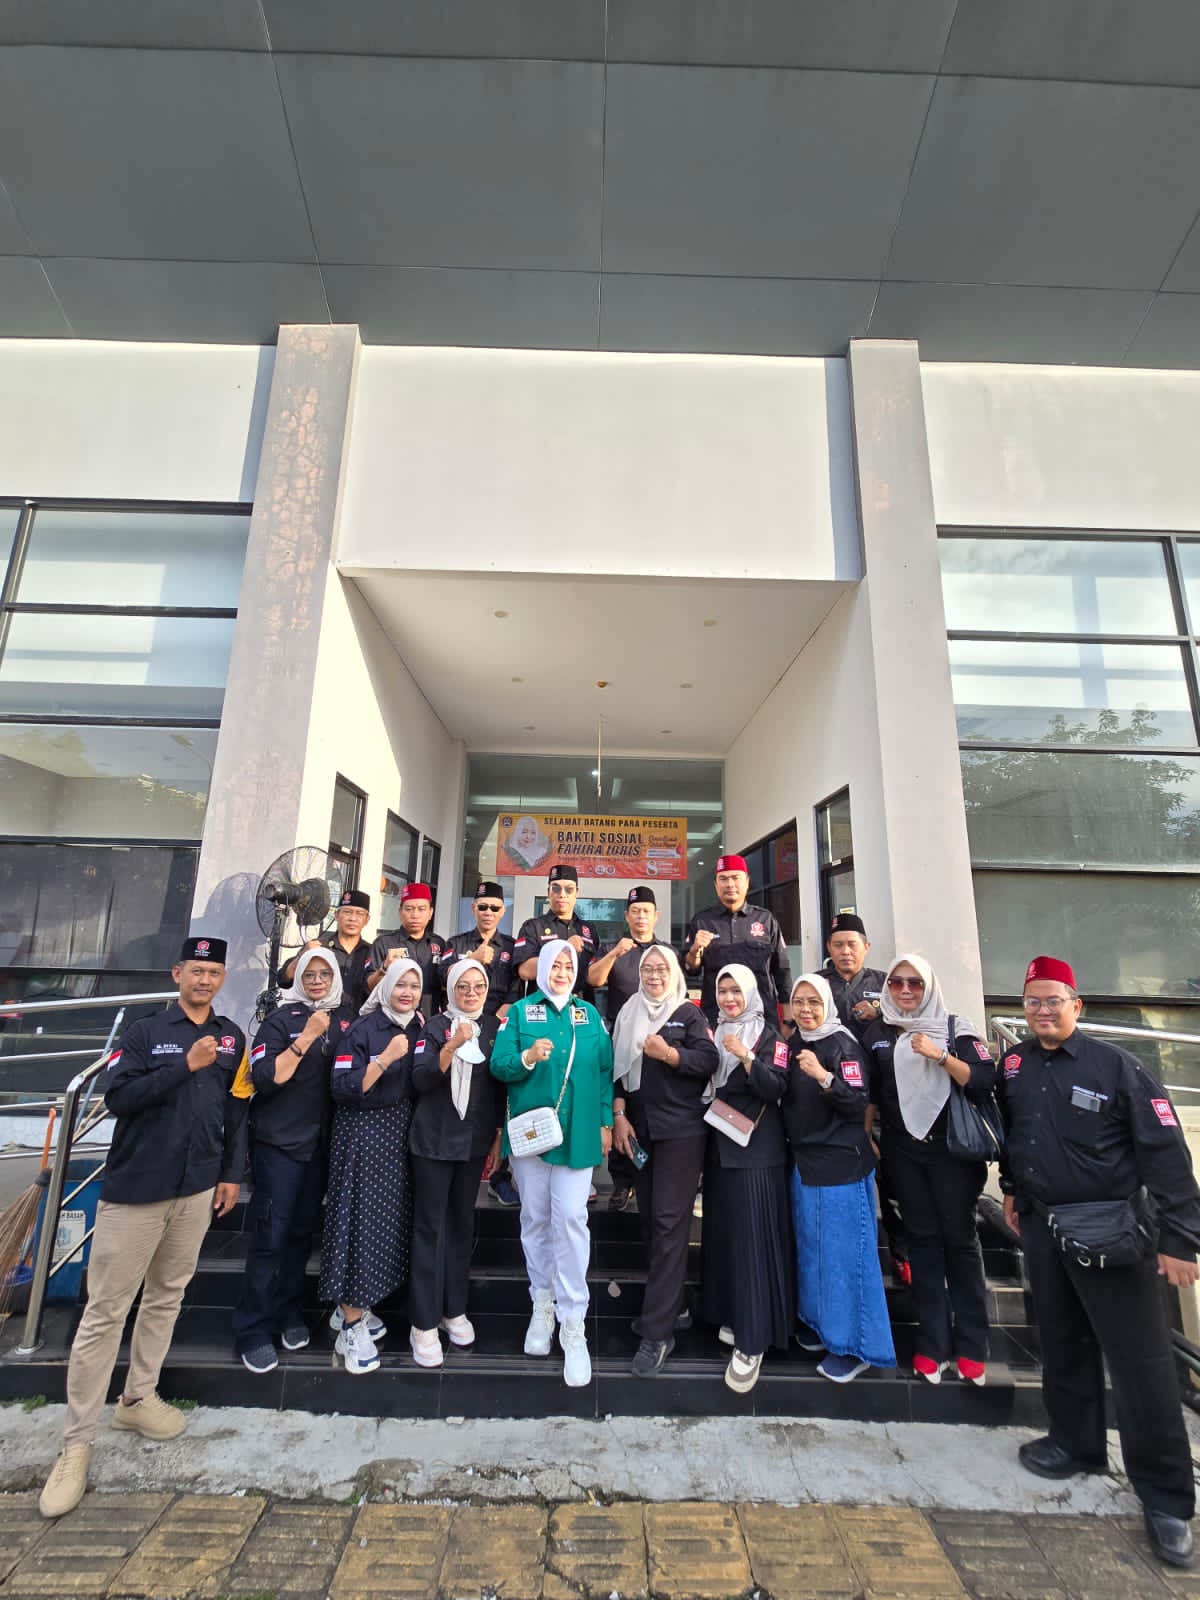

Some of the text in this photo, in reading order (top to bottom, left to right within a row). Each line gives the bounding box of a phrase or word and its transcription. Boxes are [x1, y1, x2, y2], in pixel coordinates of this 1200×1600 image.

[544, 817, 678, 829] SELAMAT DATANG PARA PESERTA
[557, 831, 594, 843] BAKTI
[599, 832, 643, 844] SOSIAL
[557, 843, 602, 855] FAHIRA
[606, 844, 641, 857] IDRIS
